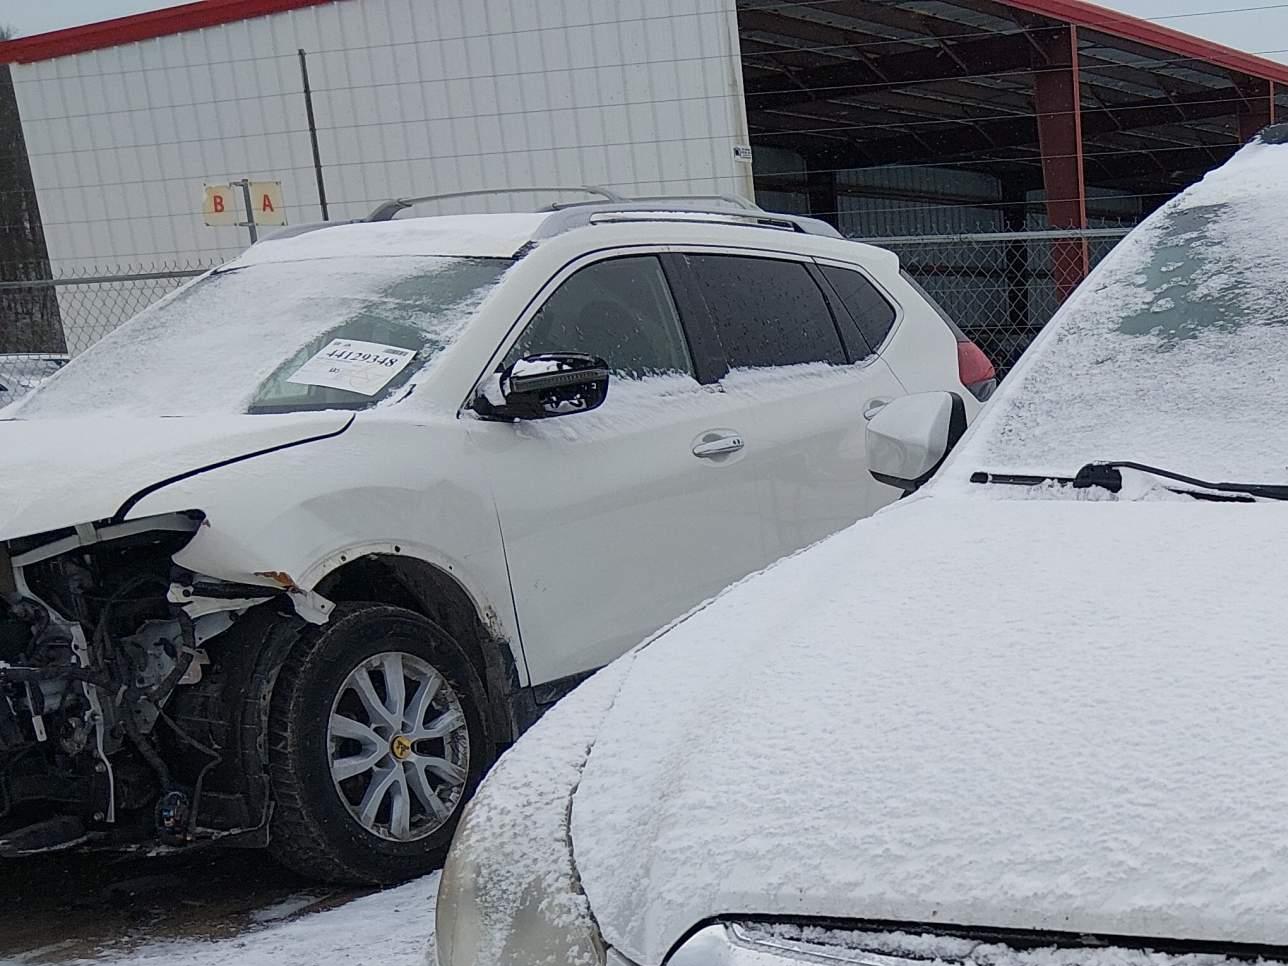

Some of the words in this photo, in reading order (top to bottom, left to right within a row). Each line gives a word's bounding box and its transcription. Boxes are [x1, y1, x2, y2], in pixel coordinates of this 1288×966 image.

[213, 195, 225, 213] B
[262, 193, 274, 212] A
[327, 349, 399, 368] 44129348
